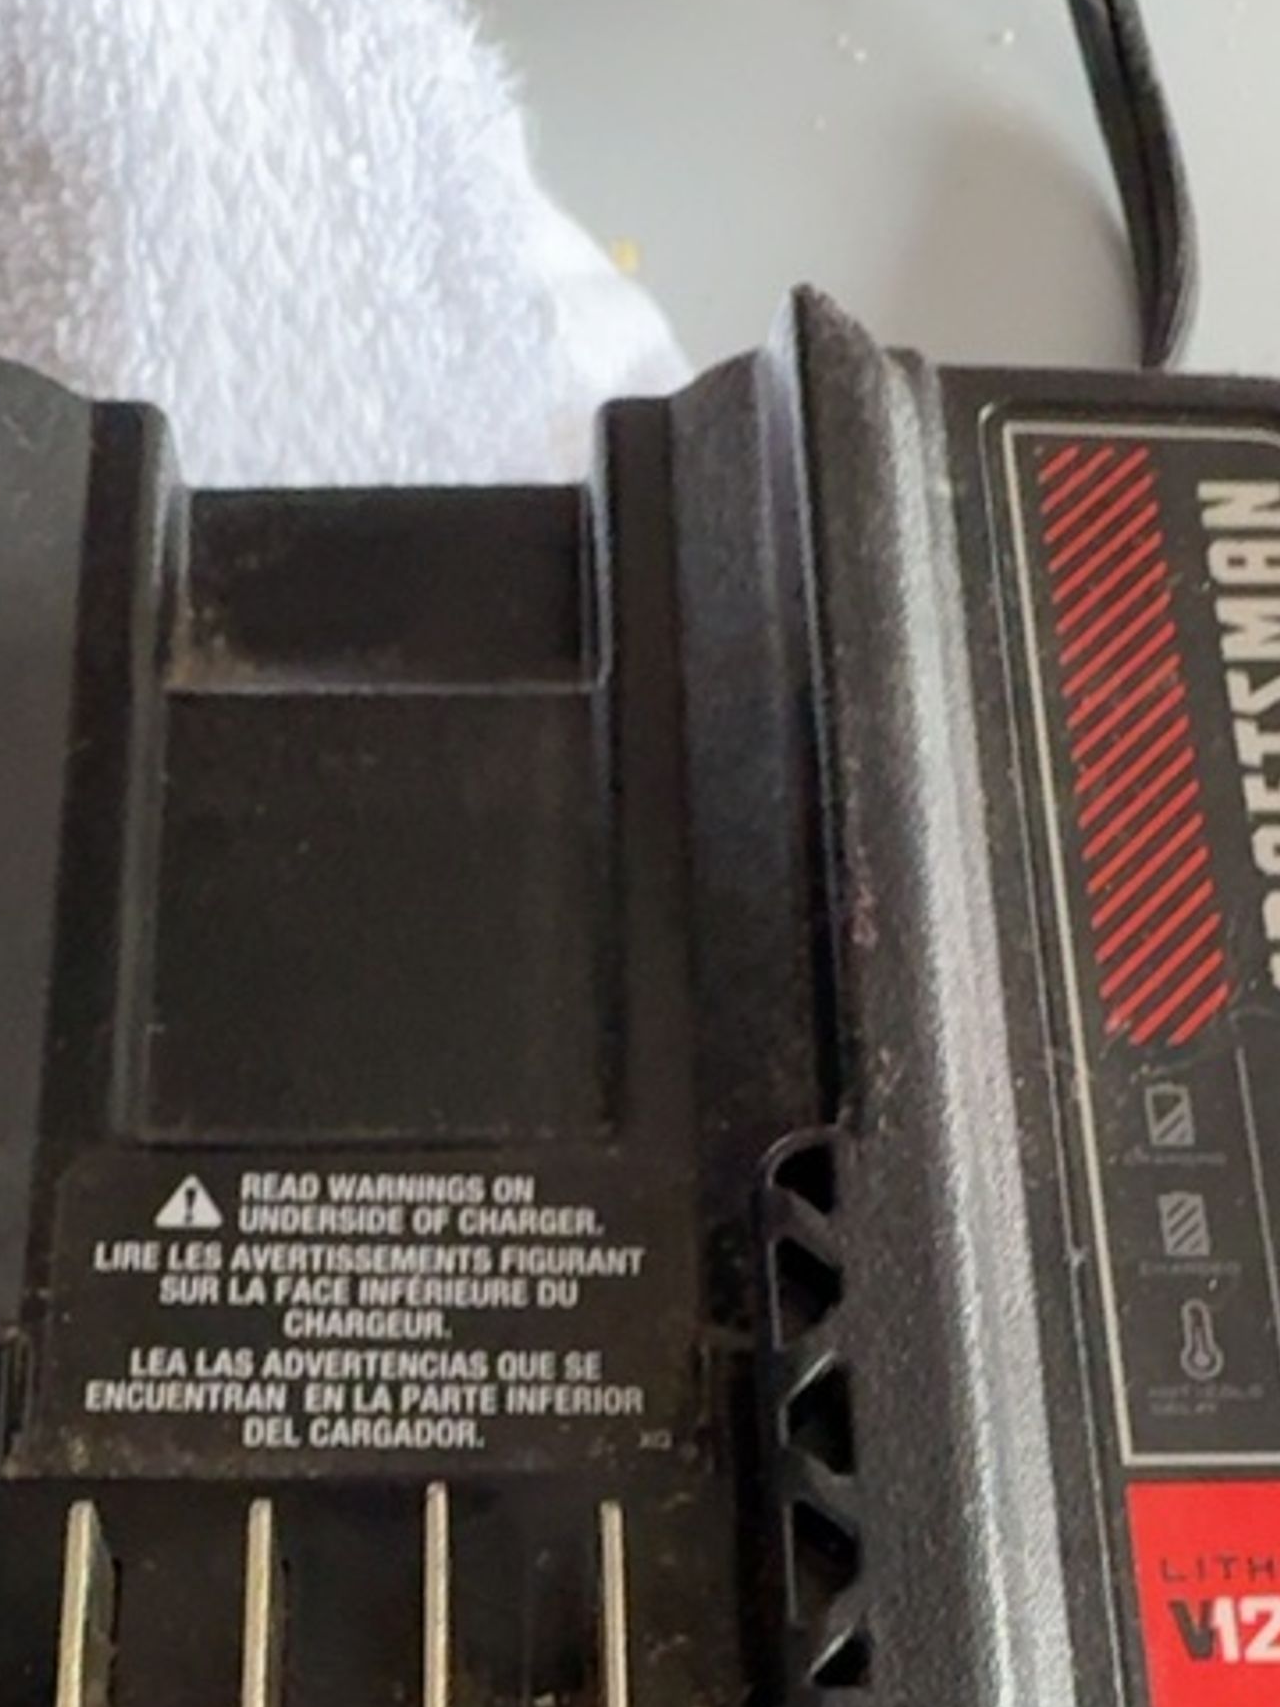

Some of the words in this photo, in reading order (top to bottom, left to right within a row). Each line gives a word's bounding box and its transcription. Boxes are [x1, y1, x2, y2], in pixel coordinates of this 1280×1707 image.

[240, 1171, 319, 1201] READ
[327, 1172, 485, 1204] WARNINGS
[492, 1174, 535, 1204] ON
[238, 1204, 405, 1236] UNDERSIDE
[411, 1206, 451, 1236] OF
[457, 1206, 605, 1238] CHARGER.
[94, 1240, 160, 1272] LIRE
[167, 1241, 223, 1273] LES
[229, 1242, 493, 1275] AVERTISSEMENTS
[499, 1245, 646, 1277] FIGURANT
[159, 1274, 220, 1305] SUR
[227, 1275, 267, 1306] LA
[273, 1275, 351, 1306] FACE
[357, 1271, 530, 1308] INFÉRIEURE
[535, 1277, 580, 1308] DU
[282, 1308, 453, 1340] CHARGEUR.
[129, 1346, 188, 1378] LEA
[194, 1347, 255, 1379] LAS
[261, 1348, 490, 1381] ADVERTENCIAS
[496, 1349, 557, 1381] QUE
[564, 1350, 603, 1382] SE
[83, 1379, 288, 1413] ENCUENTRAN
[303, 1382, 347, 1413] EN
[353, 1382, 394, 1414] LA
[400, 1383, 499, 1416] PARTE
[504, 1385, 645, 1417] INFERIOR
[242, 1415, 302, 1448] DEL
[308, 1416, 486, 1450] CARGADOR.
